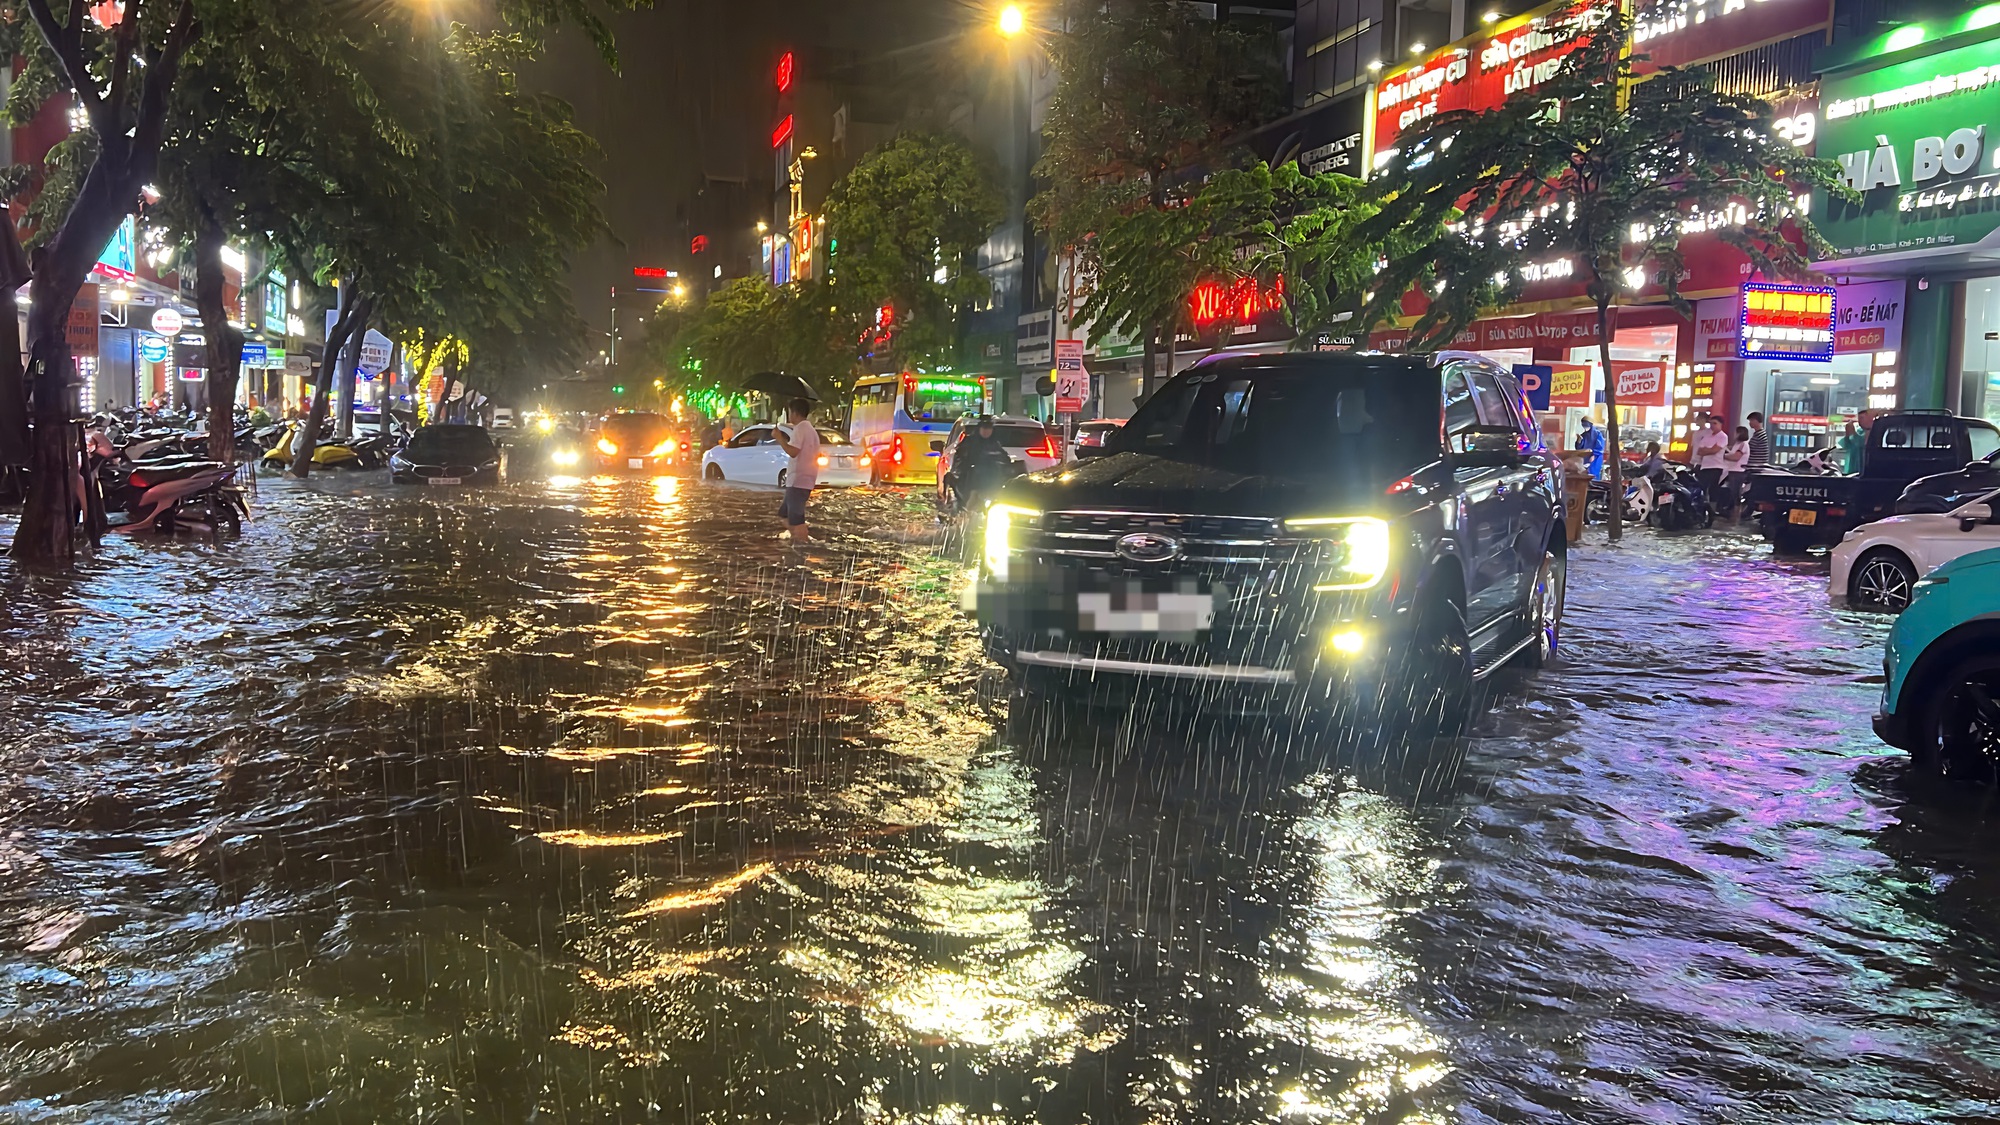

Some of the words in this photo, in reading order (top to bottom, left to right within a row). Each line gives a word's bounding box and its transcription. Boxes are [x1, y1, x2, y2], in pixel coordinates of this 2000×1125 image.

[1402, 67, 1447, 100] LAPTOP
[1446, 53, 1467, 83] CŨ
[1399, 101, 1421, 130] GIÁ
[1911, 123, 1987, 183] BƠ
[1620, 380, 1657, 394] LAPTOP
[1621, 373, 1637, 383] THU
[1638, 371, 1655, 381] MUA
[1775, 486, 1828, 498] SUZUKI
